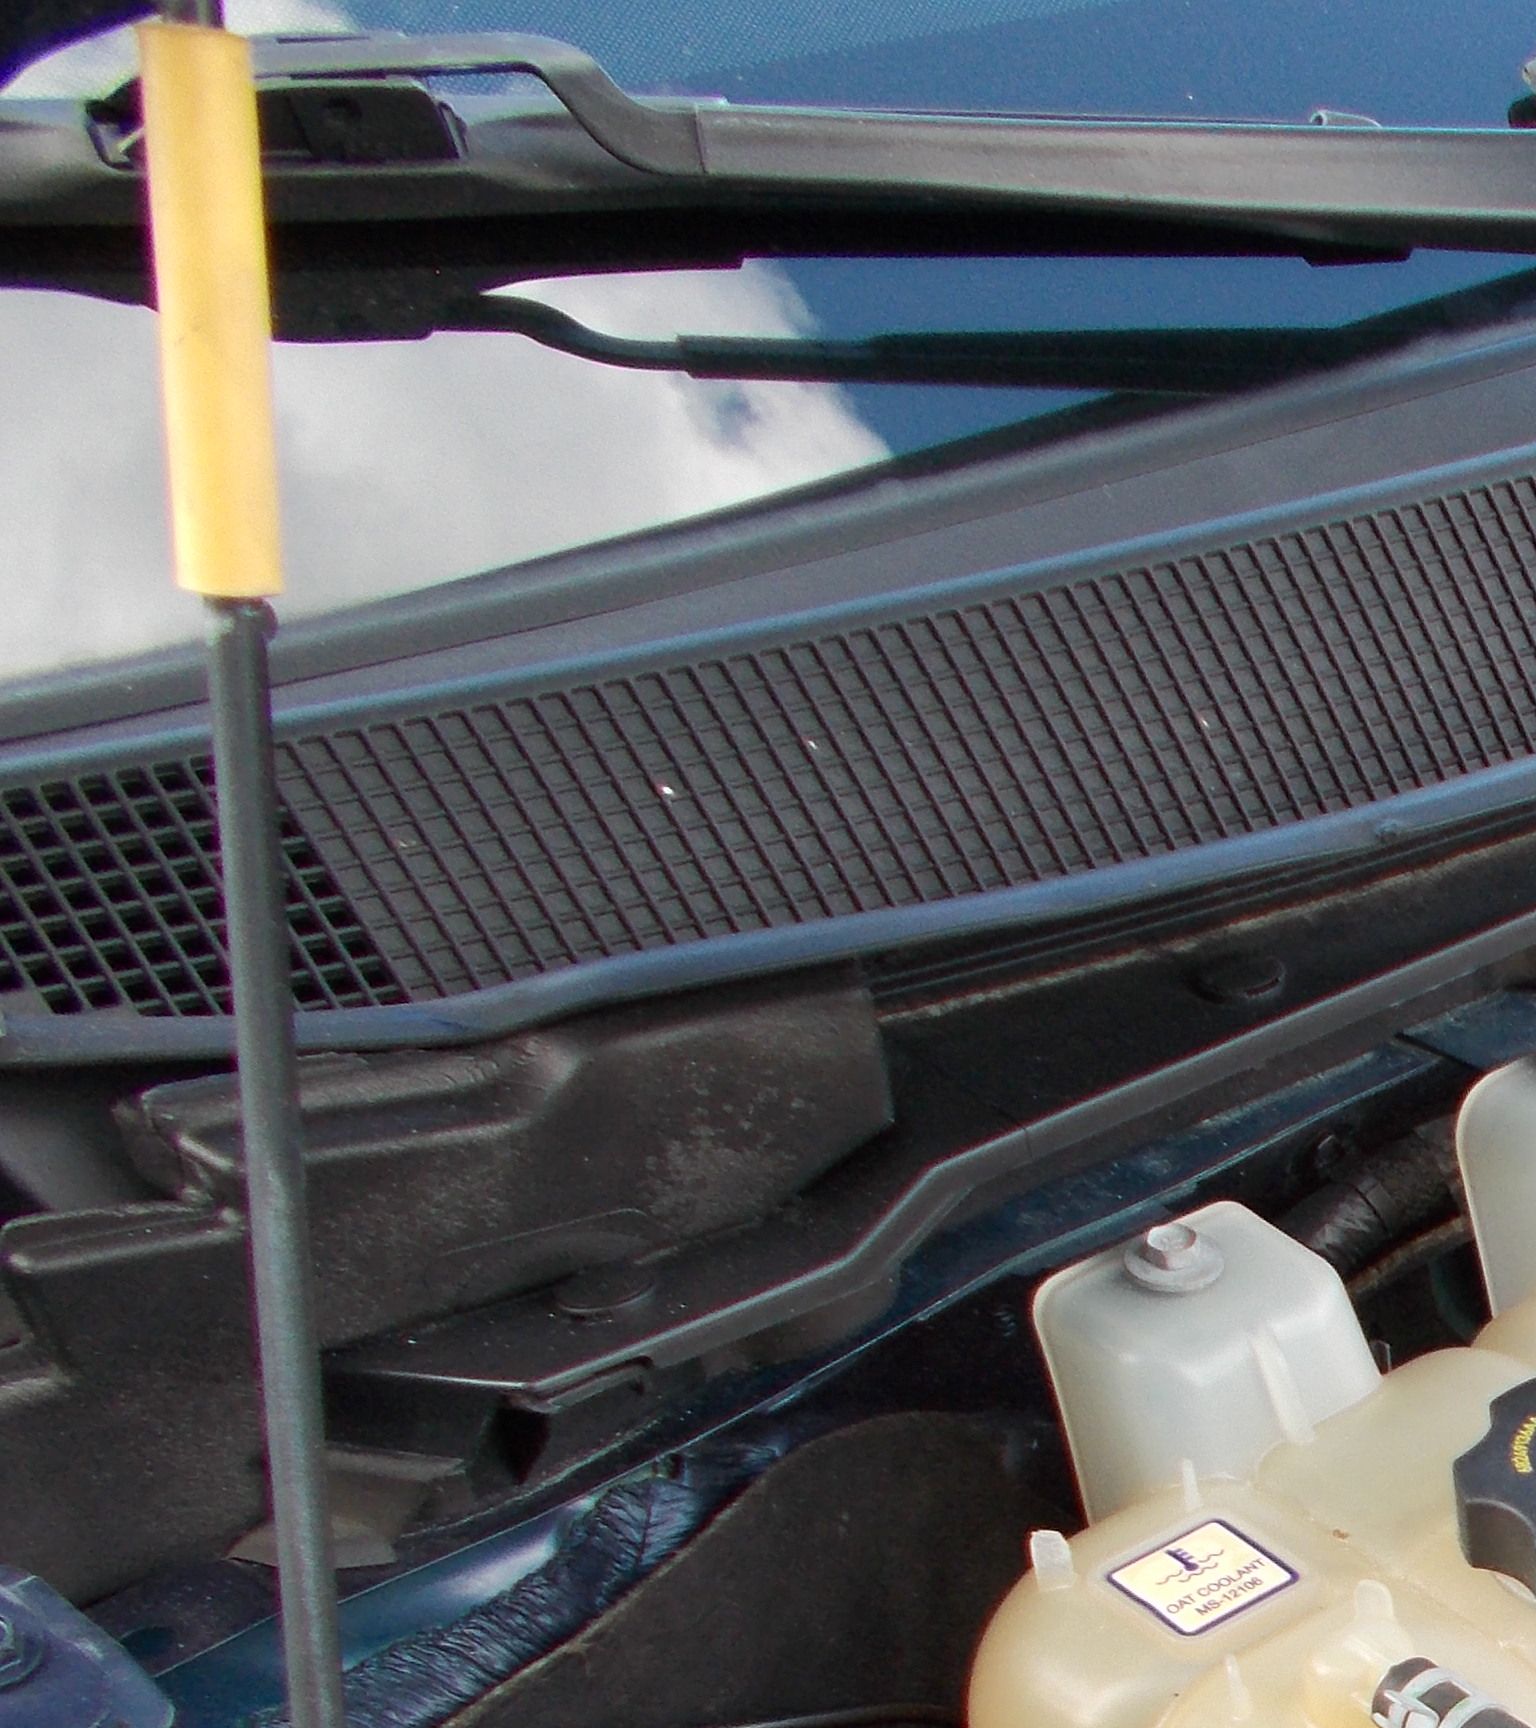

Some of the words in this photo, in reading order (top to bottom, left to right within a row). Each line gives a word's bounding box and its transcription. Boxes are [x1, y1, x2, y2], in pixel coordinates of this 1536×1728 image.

[1166, 1592, 1196, 1615] OAT
[1197, 1558, 1266, 1598] COOLANT
[1195, 1577, 1264, 1616] MS-12106
